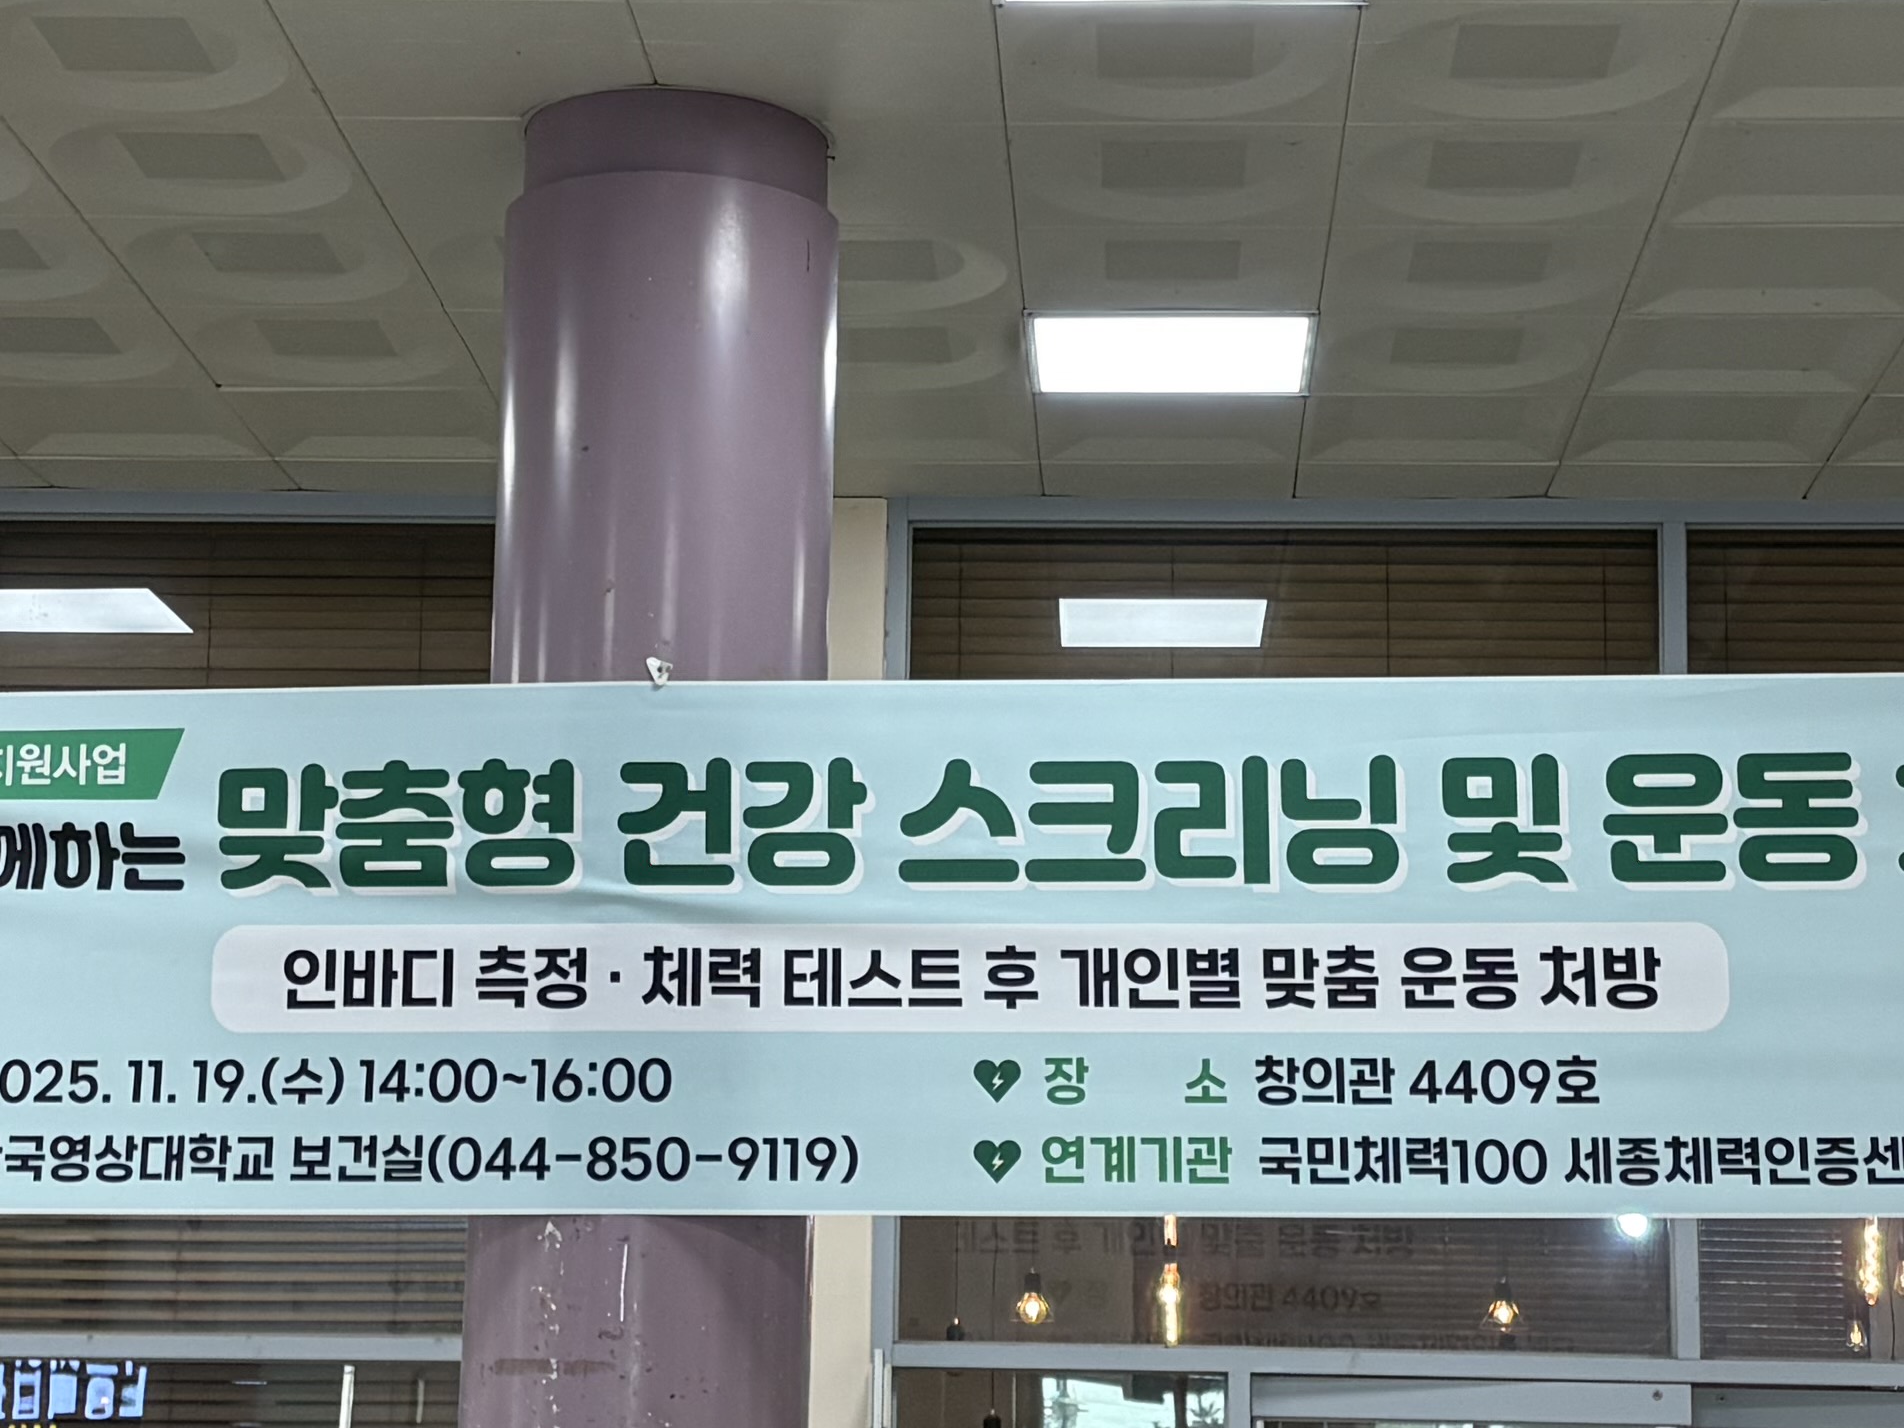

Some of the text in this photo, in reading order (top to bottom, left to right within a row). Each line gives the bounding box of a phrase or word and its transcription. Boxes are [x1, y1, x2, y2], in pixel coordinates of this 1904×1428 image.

[217, 758, 576, 890] 맞춤형
[616, 757, 868, 886] 건강
[898, 754, 1400, 885] 스크리닝
[1441, 753, 1569, 884] 및
[1602, 751, 1860, 883] 운동
[283, 948, 454, 1010] 인바디
[783, 947, 963, 1007] 테스트
[983, 945, 1039, 1010] 후
[1060, 947, 1241, 1009] 개인별
[1262, 944, 1379, 1009] 맞춤
[1400, 947, 1519, 1010] 운동
[1539, 945, 1661, 1010] 처방
[127, 1059, 177, 1104] 11.
[359, 1057, 672, 1104] 14:00~16:00
[1254, 1054, 1396, 1106] 창의관
[1409, 1054, 1600, 1105] 4409호
[289, 1134, 859, 1184] 보건실(044-850-9119)
[1041, 1135, 1233, 1184] 연계기관
[1258, 1135, 1548, 1185] 국민체력100
